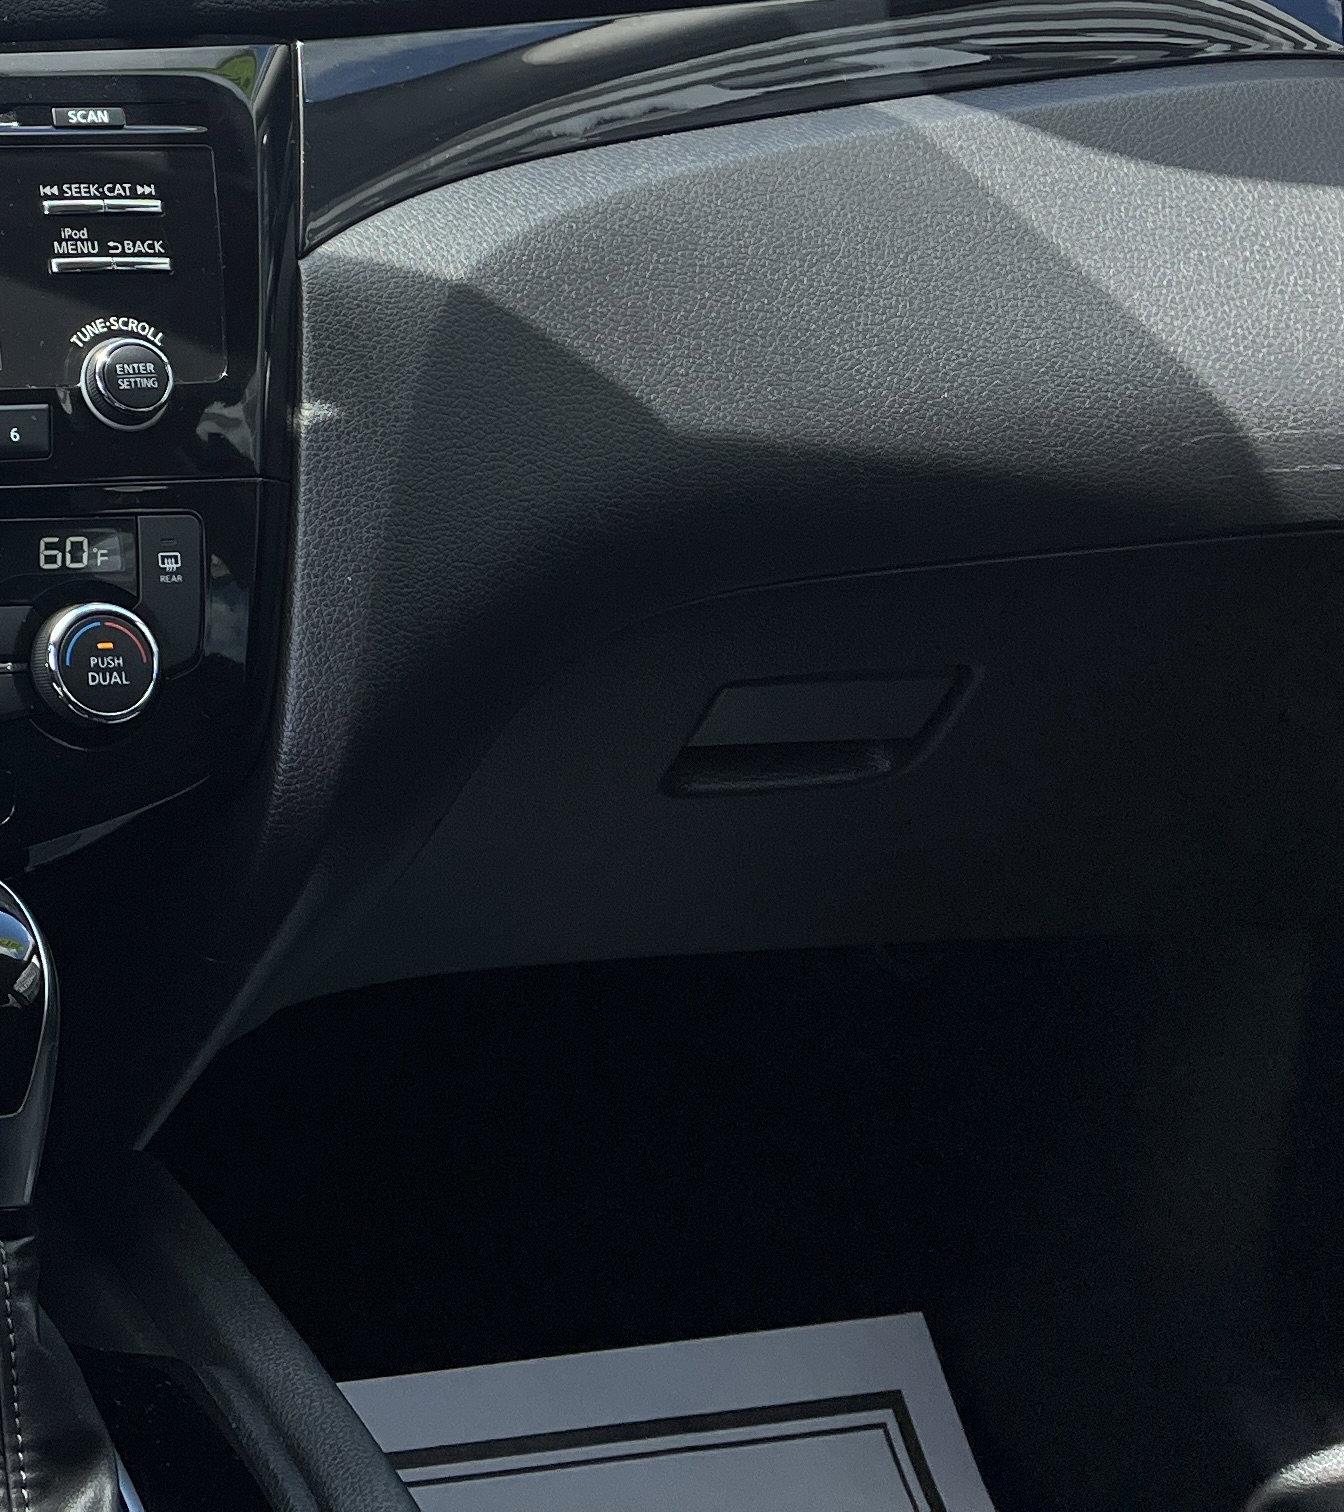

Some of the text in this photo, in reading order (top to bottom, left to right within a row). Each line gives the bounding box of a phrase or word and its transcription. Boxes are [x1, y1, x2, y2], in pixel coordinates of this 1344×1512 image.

[67, 110, 109, 123] SCAN
[61, 228, 88, 239] iPod
[54, 241, 165, 253] MENU BACK
[116, 362, 155, 375] ENTER
[118, 377, 158, 389] SETTING
[10, 427, 20, 442] 6
[159, 574, 183, 584] REAR
[89, 656, 124, 669] PUSH
[88, 672, 130, 686] DUAL
